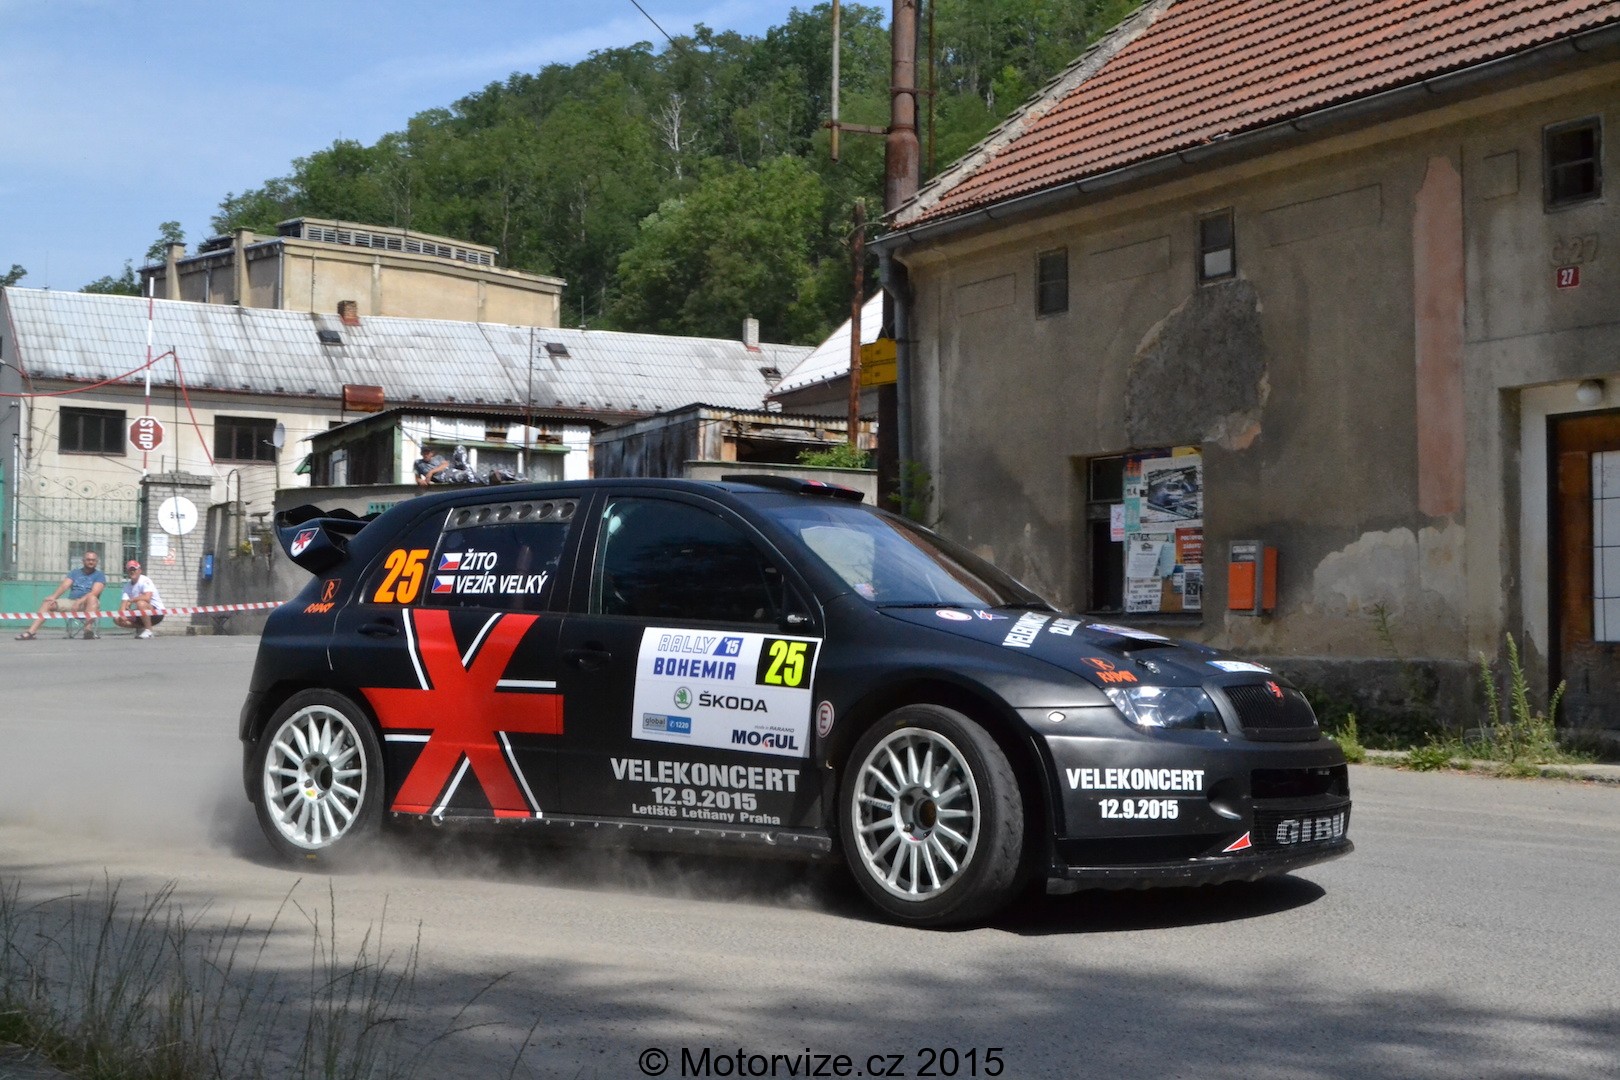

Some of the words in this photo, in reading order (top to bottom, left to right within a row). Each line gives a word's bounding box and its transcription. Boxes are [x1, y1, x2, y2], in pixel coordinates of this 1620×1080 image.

[1561, 268, 1574, 285] 27
[140, 419, 154, 450] STOP
[460, 548, 497, 571] ŽITO
[373, 549, 430, 604] 25
[456, 571, 496, 594] VEZÍR
[499, 571, 549, 594] VELKÝ
[658, 634, 716, 654] RALLY
[653, 657, 736, 680] BOHEMIA
[765, 640, 807, 686] 25
[698, 690, 768, 713] ŠKODA
[645, 717, 666, 726] global
[675, 721, 690, 729] 1220
[820, 709, 829, 729] E
[731, 729, 798, 751] MOGUL
[610, 757, 800, 792] VELEKONCERT
[1065, 768, 1205, 791] VELEKONCERT
[651, 786, 758, 811] 12.9.2015
[1099, 799, 1179, 820] 12.9.2015
[632, 803, 678, 817] Letiště
[681, 807, 736, 823] Letňany
[740, 811, 781, 825] Praha
